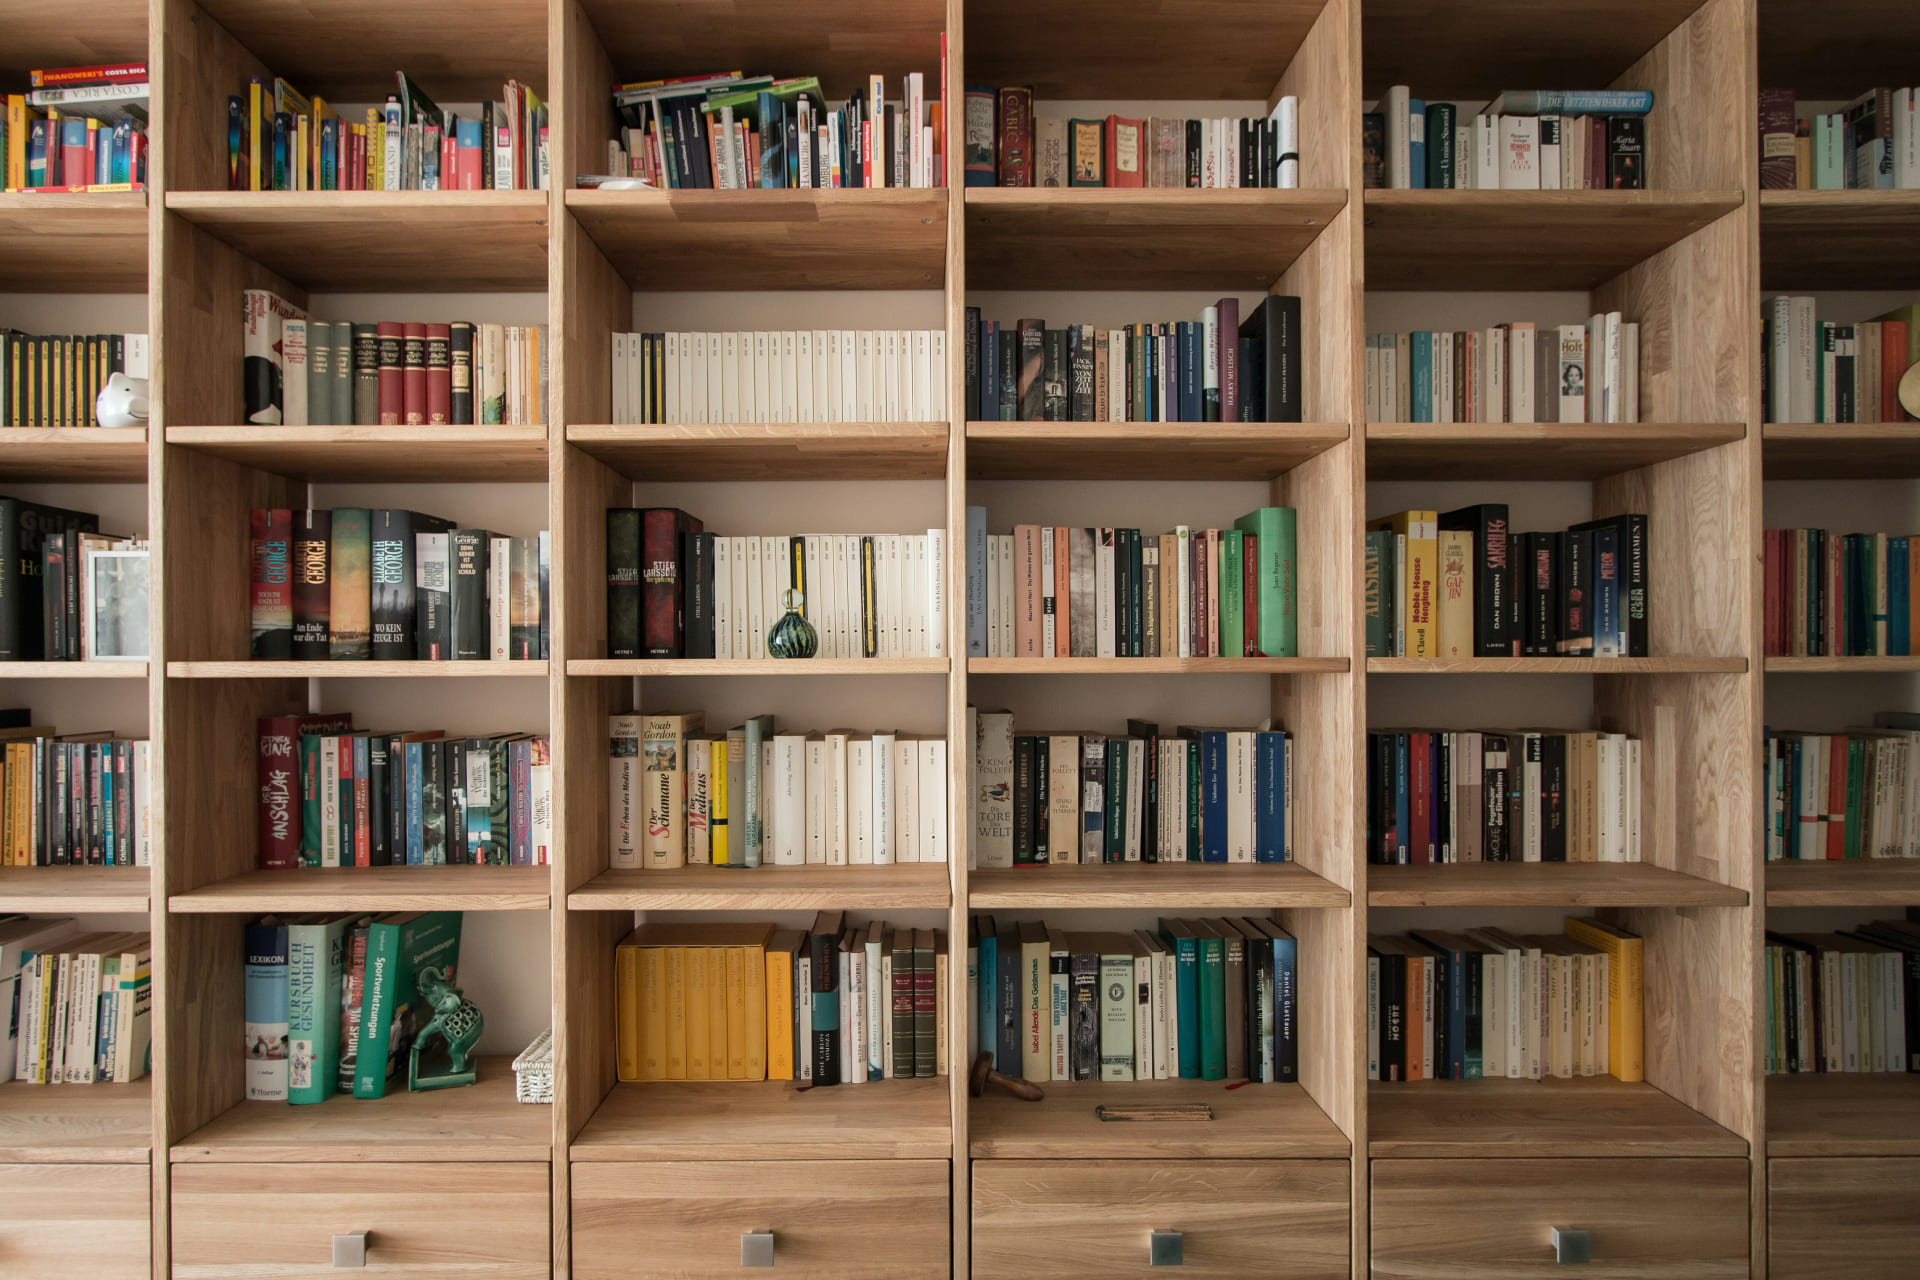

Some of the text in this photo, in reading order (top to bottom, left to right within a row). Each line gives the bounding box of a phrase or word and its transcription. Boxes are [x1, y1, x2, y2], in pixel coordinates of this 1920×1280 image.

[44, 70, 103, 81] IWANOWSKI'S
[105, 68, 127, 76] COSTA
[72, 85, 140, 98] COSTA RICA
[1630, 97, 1647, 108] ART
[1552, 121, 1560, 144] PIPER
[1562, 338, 1583, 353] Holt
[1487, 519, 1506, 568] SAKRILEG
[1631, 525, 1640, 583] ERBARMEN
[266, 541, 287, 584] GEORGE
[306, 541, 326, 584] GEORGE
[372, 541, 384, 583] ELIZABETH
[384, 541, 403, 584] GEORGE
[643, 568, 676, 577] LARSSON
[653, 561, 675, 569] STIEG
[1273, 552, 1281, 574] Regener
[1282, 559, 1290, 575] Süd
[1600, 551, 1614, 579] METEOR
[432, 561, 444, 587] GEORGE
[1365, 556, 1379, 618] ALASKA
[1412, 557, 1425, 654] Clavell Noble House
[1421, 580, 1430, 623] Hongkong
[296, 623, 324, 632] Am Ende
[304, 632, 316, 641] die
[316, 633, 328, 642] Tat
[373, 633, 404, 643] ZEUGE IST
[375, 624, 402, 632] WO KEIN
[617, 721, 633, 729] Noah
[643, 730, 676, 740] Gordon
[648, 720, 671, 730] Noah
[262, 743, 292, 757] KING
[475, 765, 483, 793] Walters
[978, 767, 1012, 775] FOLLETT
[261, 783, 271, 803] DER
[269, 769, 290, 840] ANSCHLAG
[619, 761, 630, 844] Die Erben des Medicus
[689, 773, 707, 832] Medicus
[1495, 771, 1503, 826] der Eitelkeiten
[538, 797, 546, 825] Walters
[648, 773, 670, 839] Schamane
[648, 808, 657, 825] Der
[979, 812, 1011, 821] TORE
[977, 827, 1012, 837] WELT
[1488, 786, 1501, 856] WOLFE Fegefeuer
[249, 955, 285, 964] LEXIKON
[290, 942, 302, 1031] KURSBUCH
[302, 943, 315, 1031] GESUNDHEIT
[368, 956, 386, 1039] Sportverletzungen
[350, 1010, 361, 1024] IM
[1031, 958, 1039, 1053] Isabel Allende Das Geisterhaus
[1392, 1005, 1400, 1041] MOORE
[257, 1088, 283, 1096] Thieme
